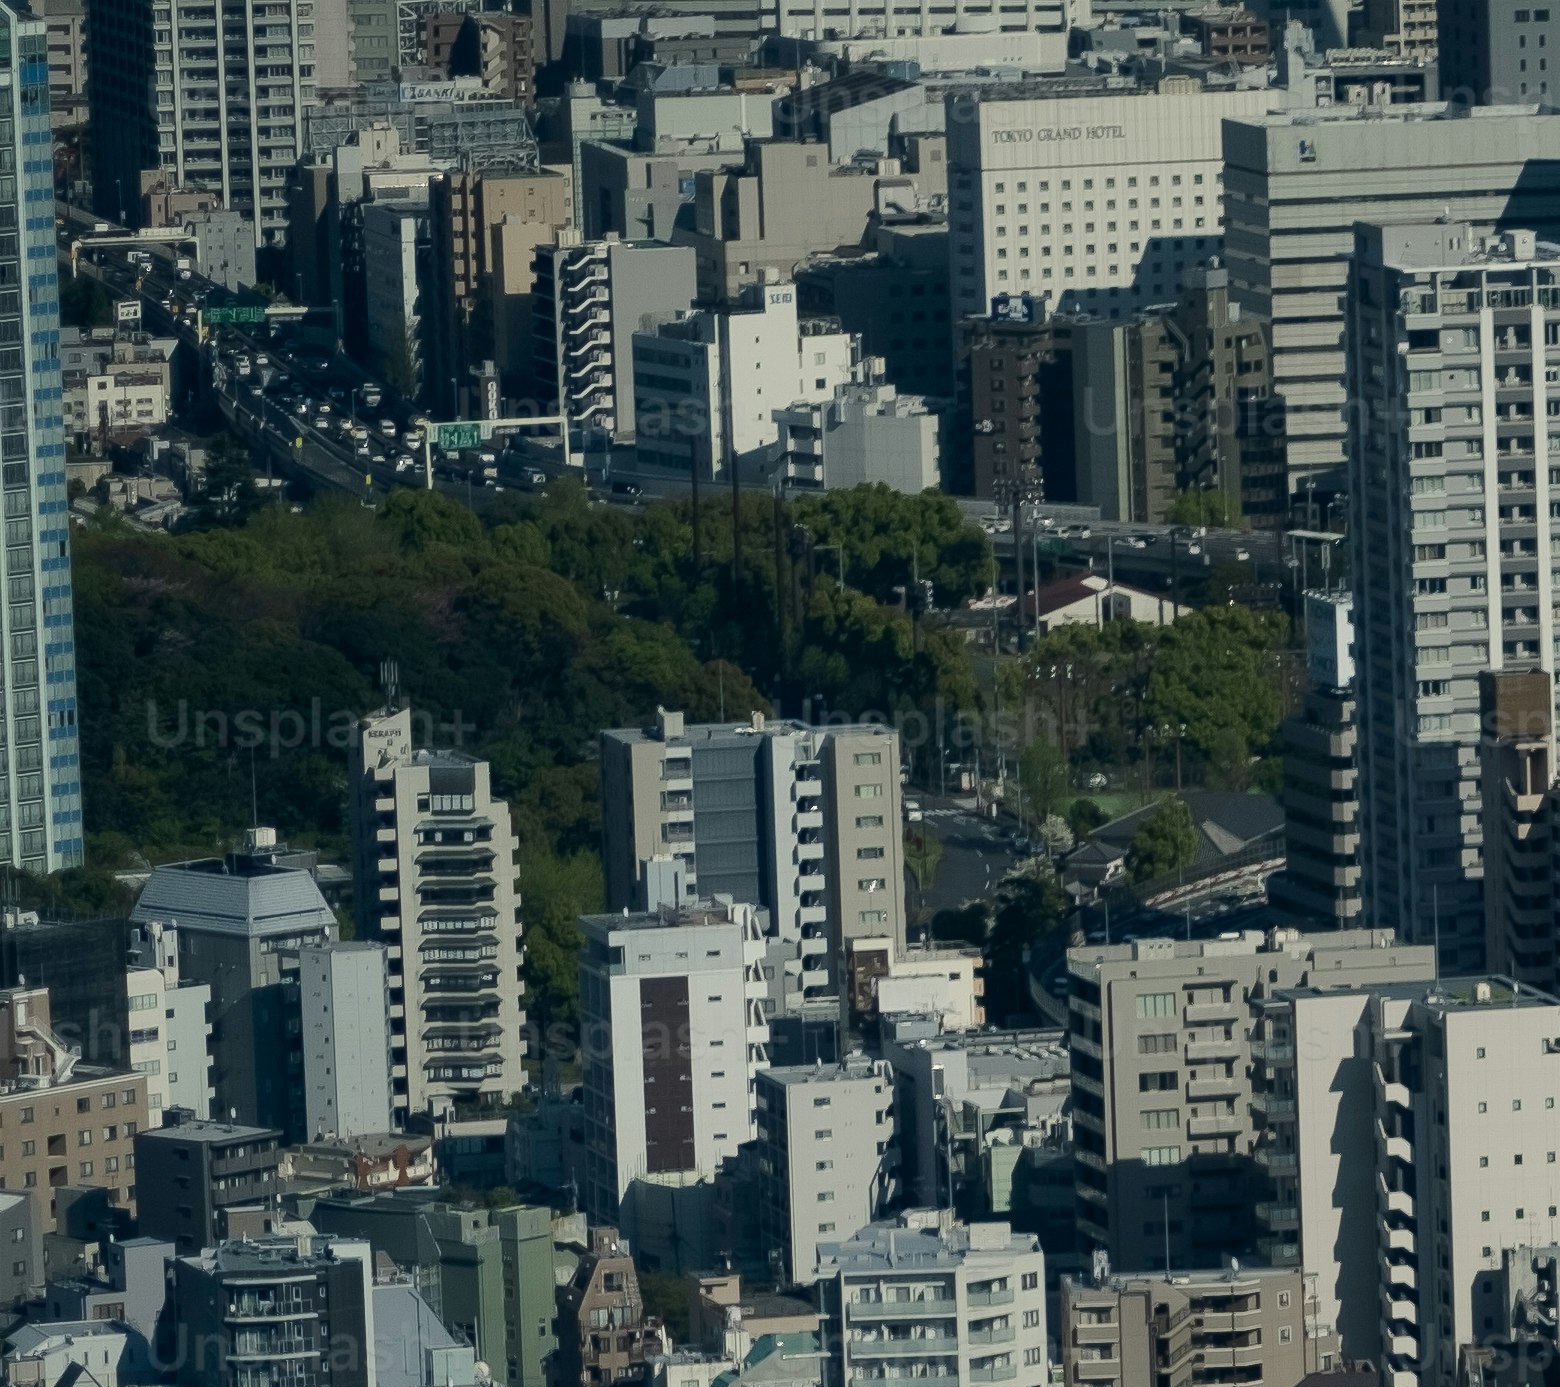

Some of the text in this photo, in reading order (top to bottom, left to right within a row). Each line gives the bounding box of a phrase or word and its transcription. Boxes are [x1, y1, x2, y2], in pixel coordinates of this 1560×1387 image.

[992, 125, 1126, 144] TOKYO GRAND HOTEL
